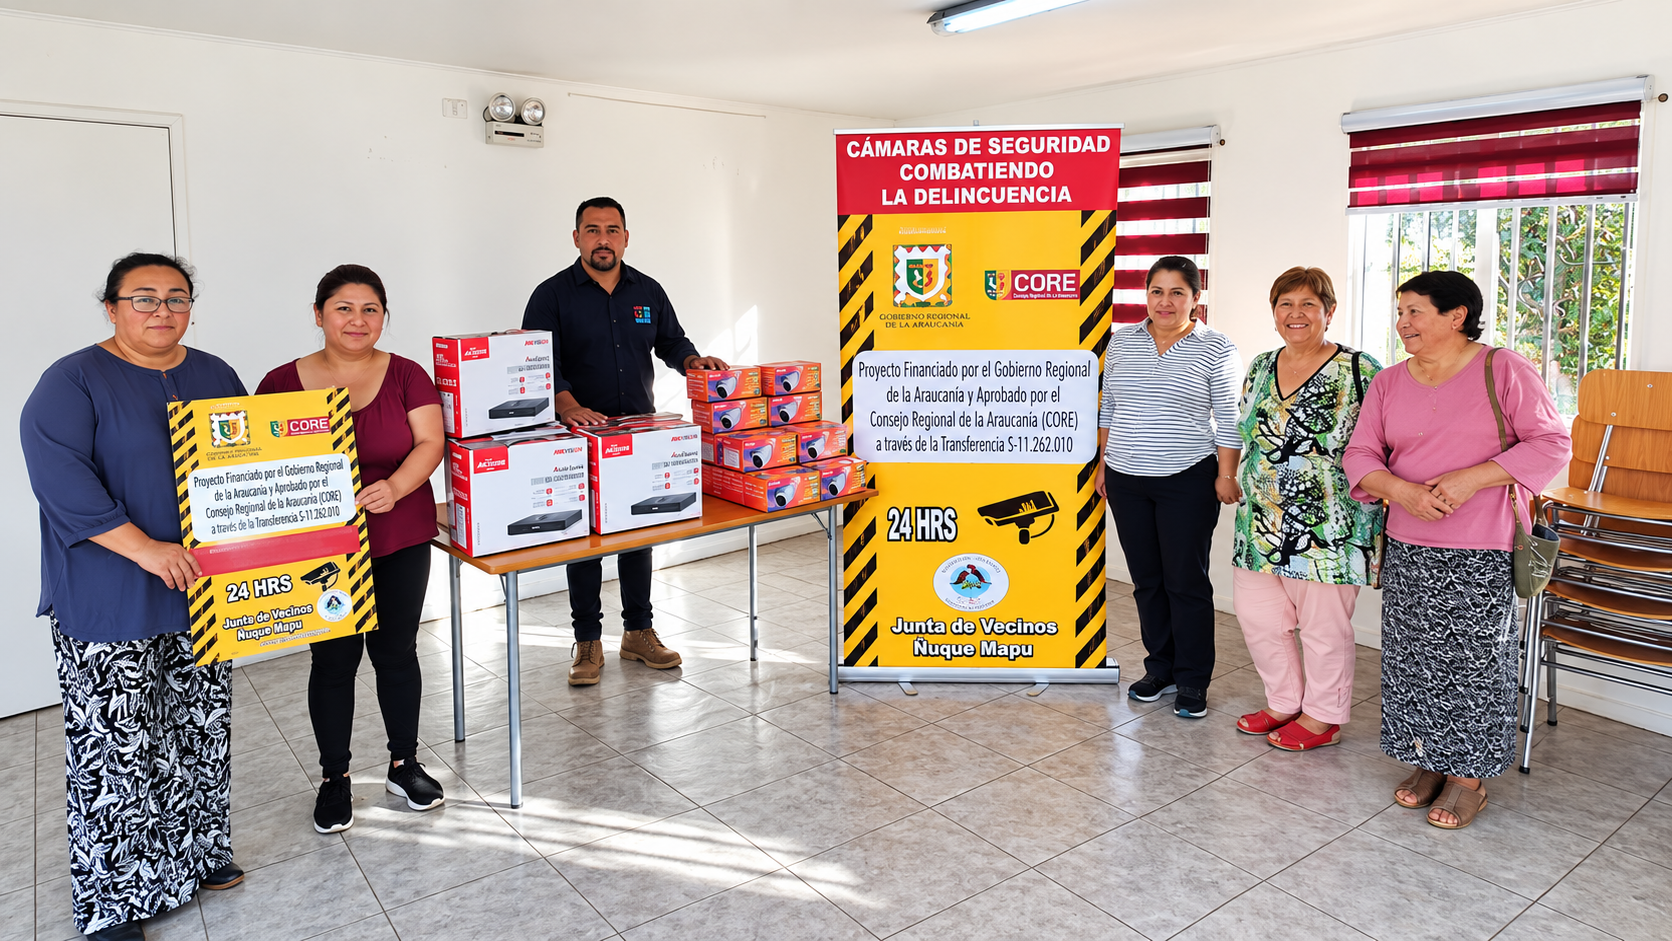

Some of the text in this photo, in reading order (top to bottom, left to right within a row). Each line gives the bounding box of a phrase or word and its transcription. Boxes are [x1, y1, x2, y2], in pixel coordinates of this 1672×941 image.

[847, 135, 1110, 157] CÁMARAS DE SEGURIDAD
[900, 162, 1054, 180] COMBATIENDO
[882, 186, 1072, 205] LA DELINCUENCIA
[1014, 274, 1076, 292] CORE
[859, 360, 1091, 381] Proyecto Financiado por el Gobierno Regional
[887, 386, 1060, 406] de la Araucanía y Aprobado por el
[290, 418, 328, 432] CORE
[870, 411, 1078, 431] Consejo Regional de la Araucanía (CORE)
[876, 435, 1073, 452] a través de la Transferencia S-11.262.010
[194, 459, 343, 488] Proyecto Financiado por el Gobierno Regional
[215, 490, 223, 501] de
[225, 489, 231, 499] la
[269, 487, 273, 496] y
[275, 479, 307, 495] Aprobado
[309, 480, 320, 491] por
[322, 476, 328, 487] el
[206, 505, 233, 519] Consejo
[236, 500, 266, 516] Regional
[268, 499, 276, 510] de
[278, 498, 284, 508] la
[319, 490, 341, 505] (CORE)
[212, 526, 216, 534] a
[238, 519, 246, 531] de
[248, 518, 254, 529] la
[887, 507, 958, 542] 24 HRS
[226, 574, 293, 603] 24 HRS
[256, 611, 269, 623] de
[891, 618, 1058, 635] Junta de Vecinos
[913, 636, 1033, 660] Ñuque Mapu
